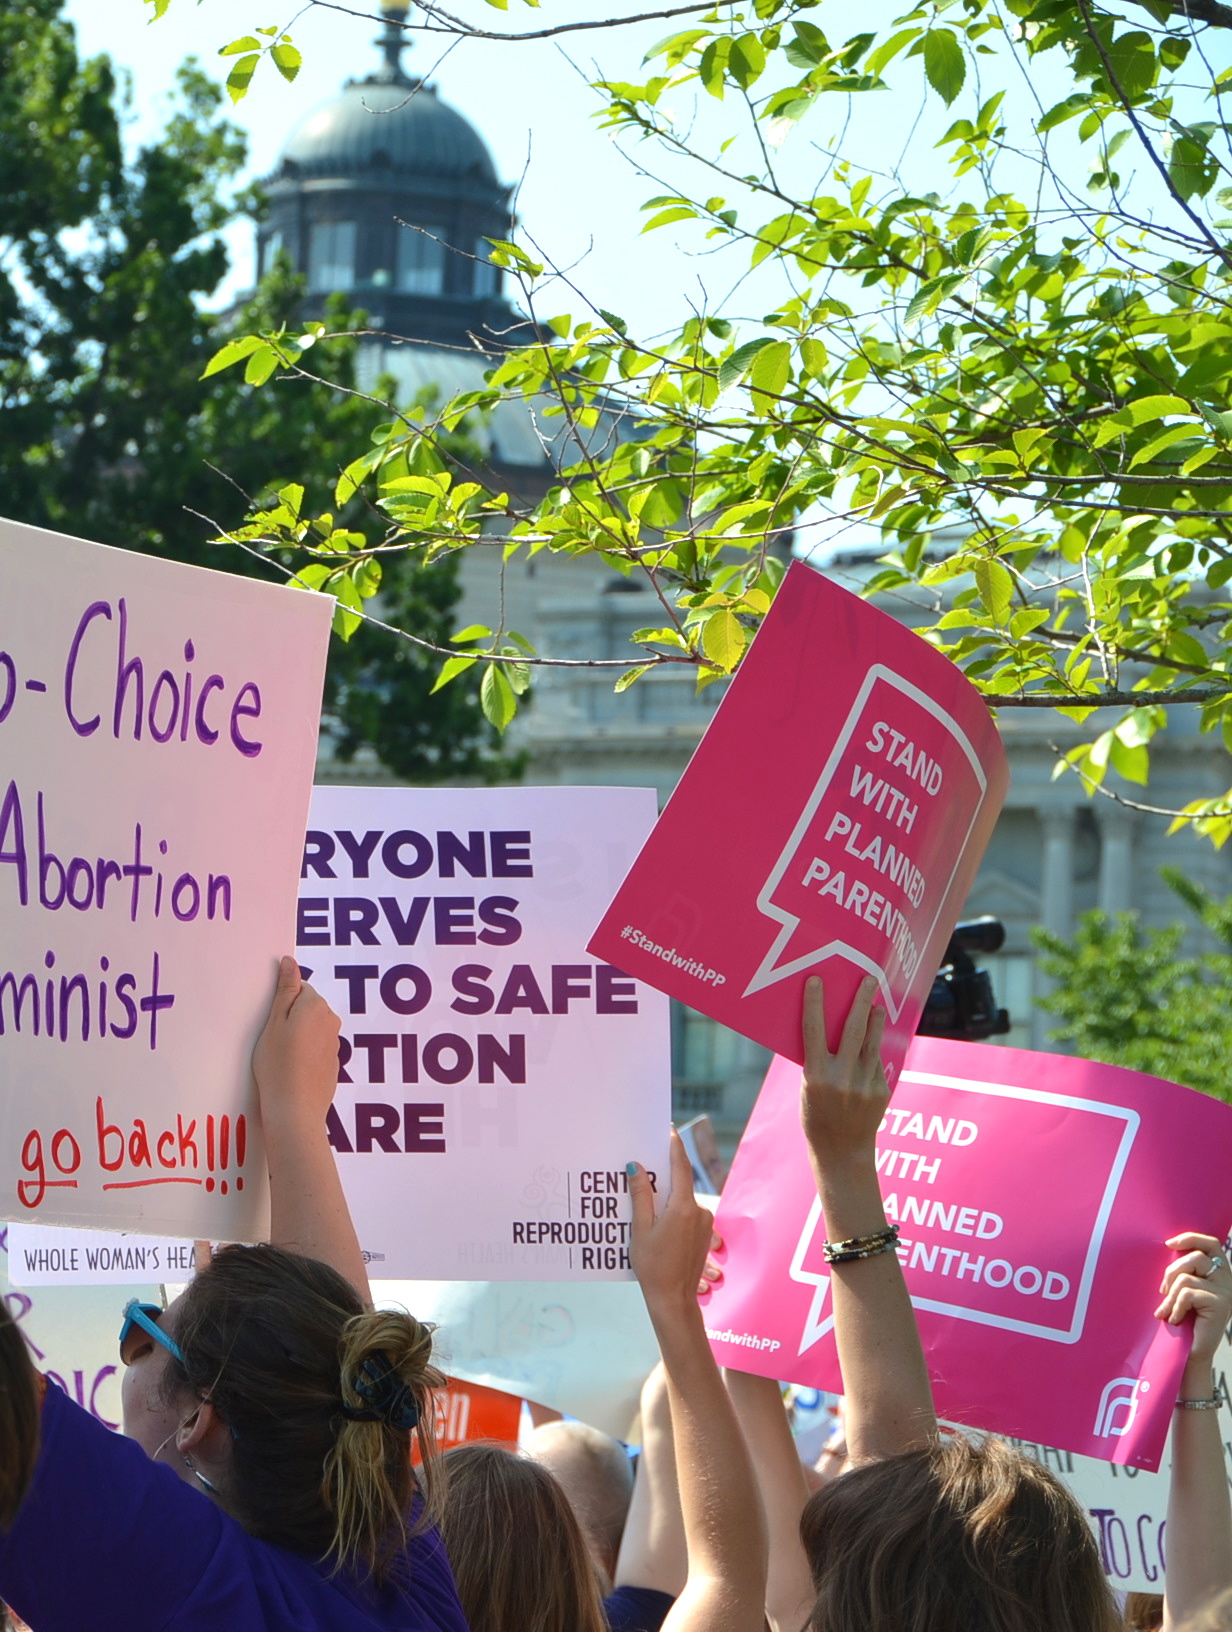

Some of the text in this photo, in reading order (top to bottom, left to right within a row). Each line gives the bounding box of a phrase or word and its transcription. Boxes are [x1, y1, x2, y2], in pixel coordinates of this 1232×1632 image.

[865, 721, 943, 797] STAND
[849, 764, 919, 834] WITH
[300, 830, 534, 879] RYONE
[824, 811, 926, 909] PLANNED
[295, 895, 523, 946] ERVES
[801, 857, 918, 981] PARENTHOOD
[620, 925, 727, 988] #StandwithPP
[334, 963, 639, 1016] TO SAFE
[337, 1032, 527, 1085] RTION
[18, 1128, 81, 1208] go
[96, 1096, 246, 1195] back!!!
[326, 1103, 447, 1153] ARE
[580, 1171, 657, 1193] CENTR
[581, 1196, 618, 1219] FOR
[883, 1193, 1004, 1240] ANNED
[24, 1245, 197, 1272] WHOLE WOMAN'S HEA
[582, 1247, 632, 1270] RIGH
[895, 1238, 1070, 1301] ENTHOOD
[705, 1327, 782, 1353] andwithPP
